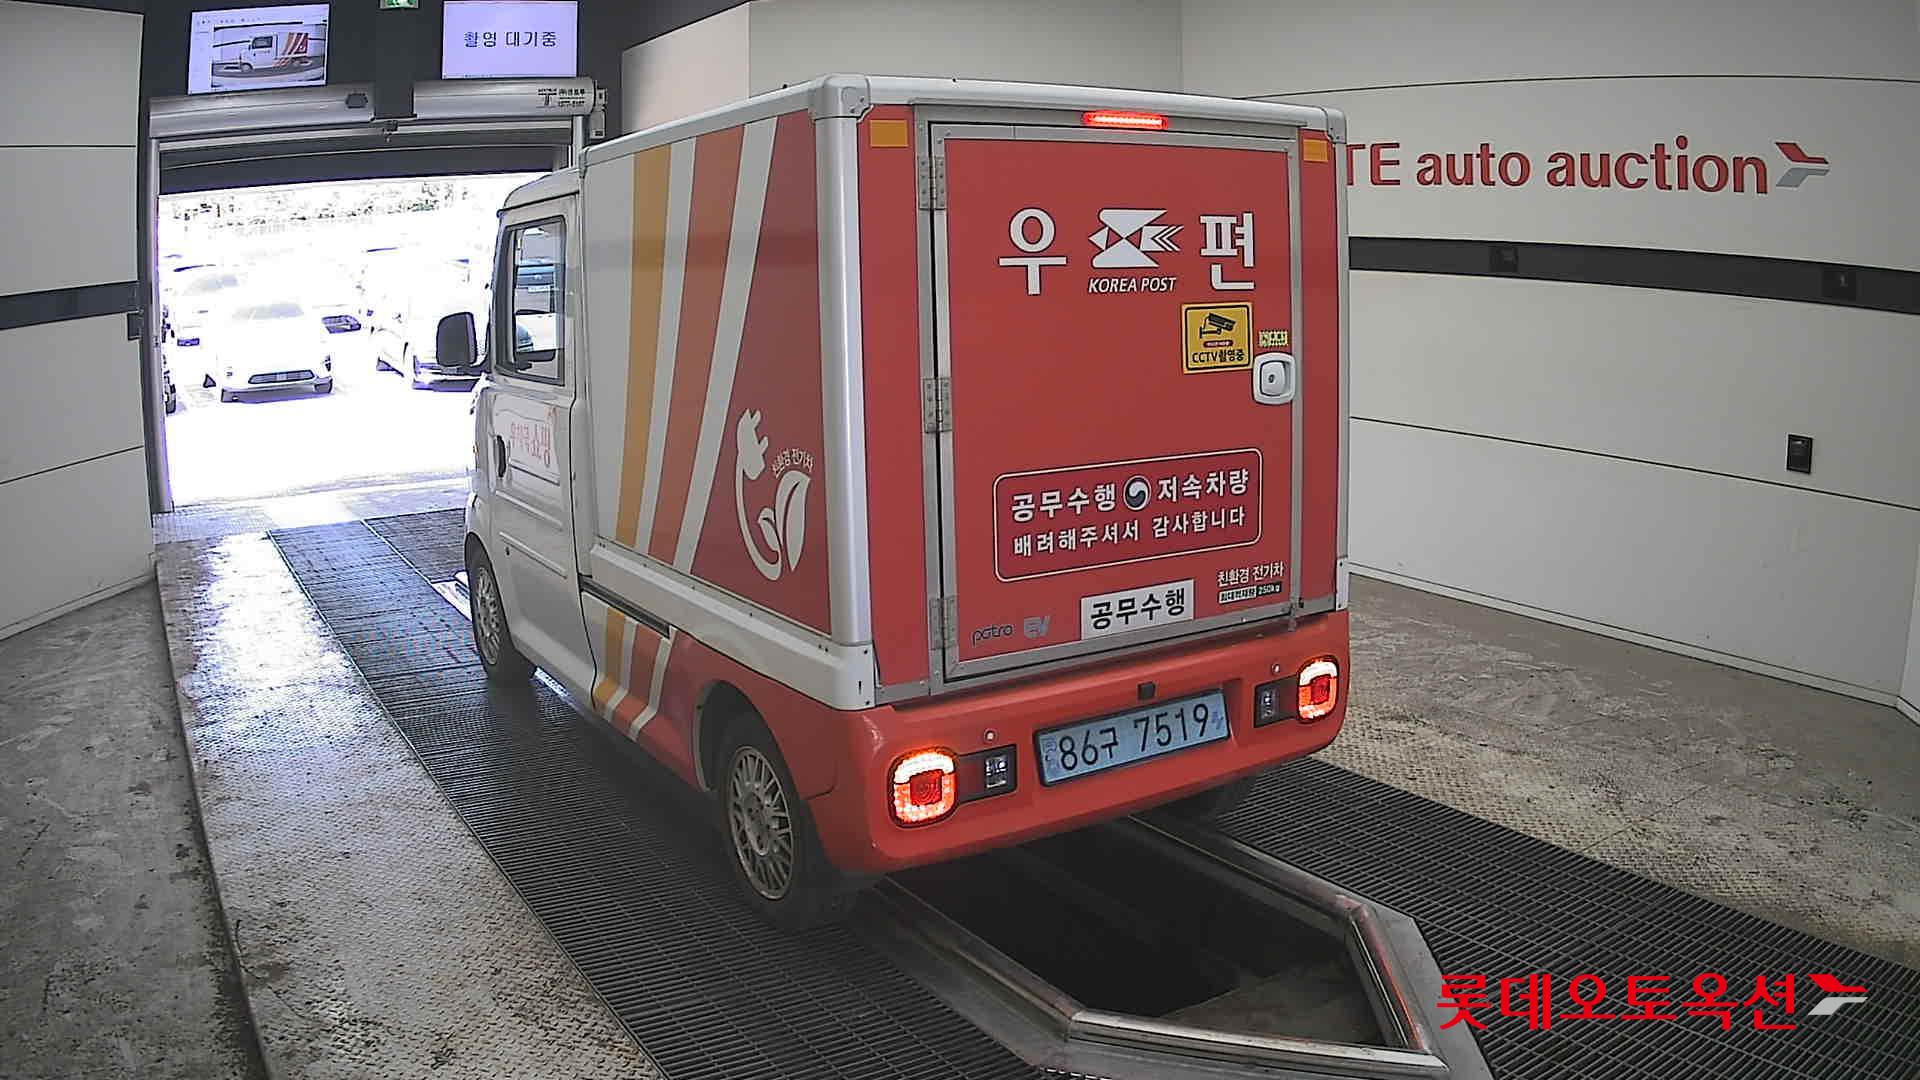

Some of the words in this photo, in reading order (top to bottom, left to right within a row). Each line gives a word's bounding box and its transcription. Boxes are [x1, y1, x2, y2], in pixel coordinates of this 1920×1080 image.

[464, 31, 497, 48] 촬영
[505, 31, 557, 48] 대기중
[1416, 142, 1531, 188] auto
[1546, 135, 1769, 194] auction
[998, 207, 1068, 295] 우
[1199, 211, 1256, 290] 편
[1088, 278, 1138, 294] KOREA
[1141, 277, 1177, 292] POST
[1011, 482, 1117, 523] 공무수행
[1157, 468, 1249, 503] 저속차량
[1013, 519, 1141, 557] 배려해주셔서
[1151, 505, 1246, 539] 감사합니다
[1217, 568, 1250, 588] 친환경
[1252, 560, 1285, 581] 전기차
[1090, 587, 1186, 630] 공무수행
[1058, 726, 1119, 771] 86구
[1133, 703, 1209, 752] 7519
